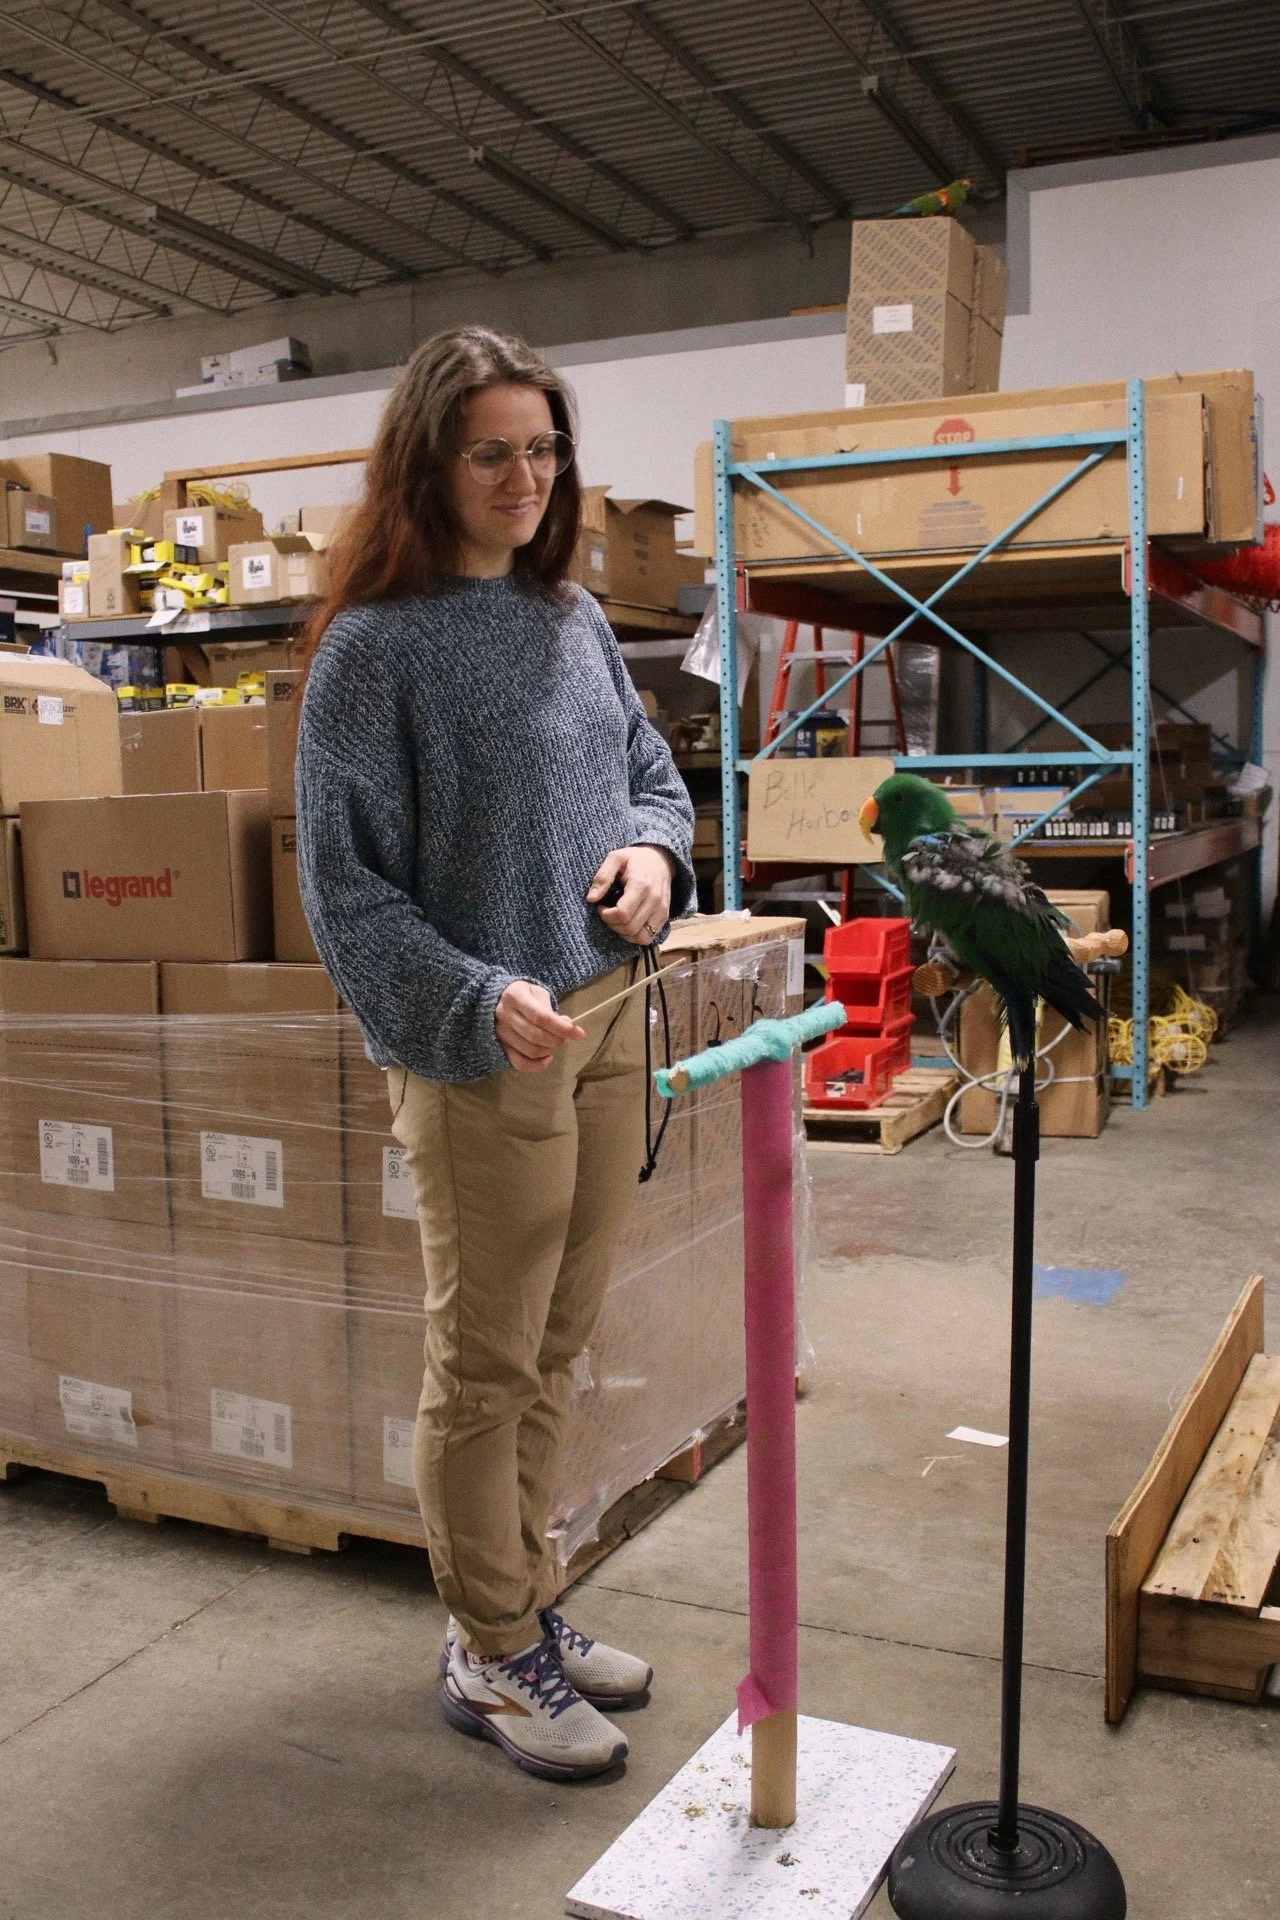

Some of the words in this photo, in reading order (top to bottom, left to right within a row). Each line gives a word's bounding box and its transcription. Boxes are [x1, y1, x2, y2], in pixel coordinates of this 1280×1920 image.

[937, 430, 971, 444] STOP
[4, 696, 26, 709] BRK
[83, 868, 173, 907] legrand
